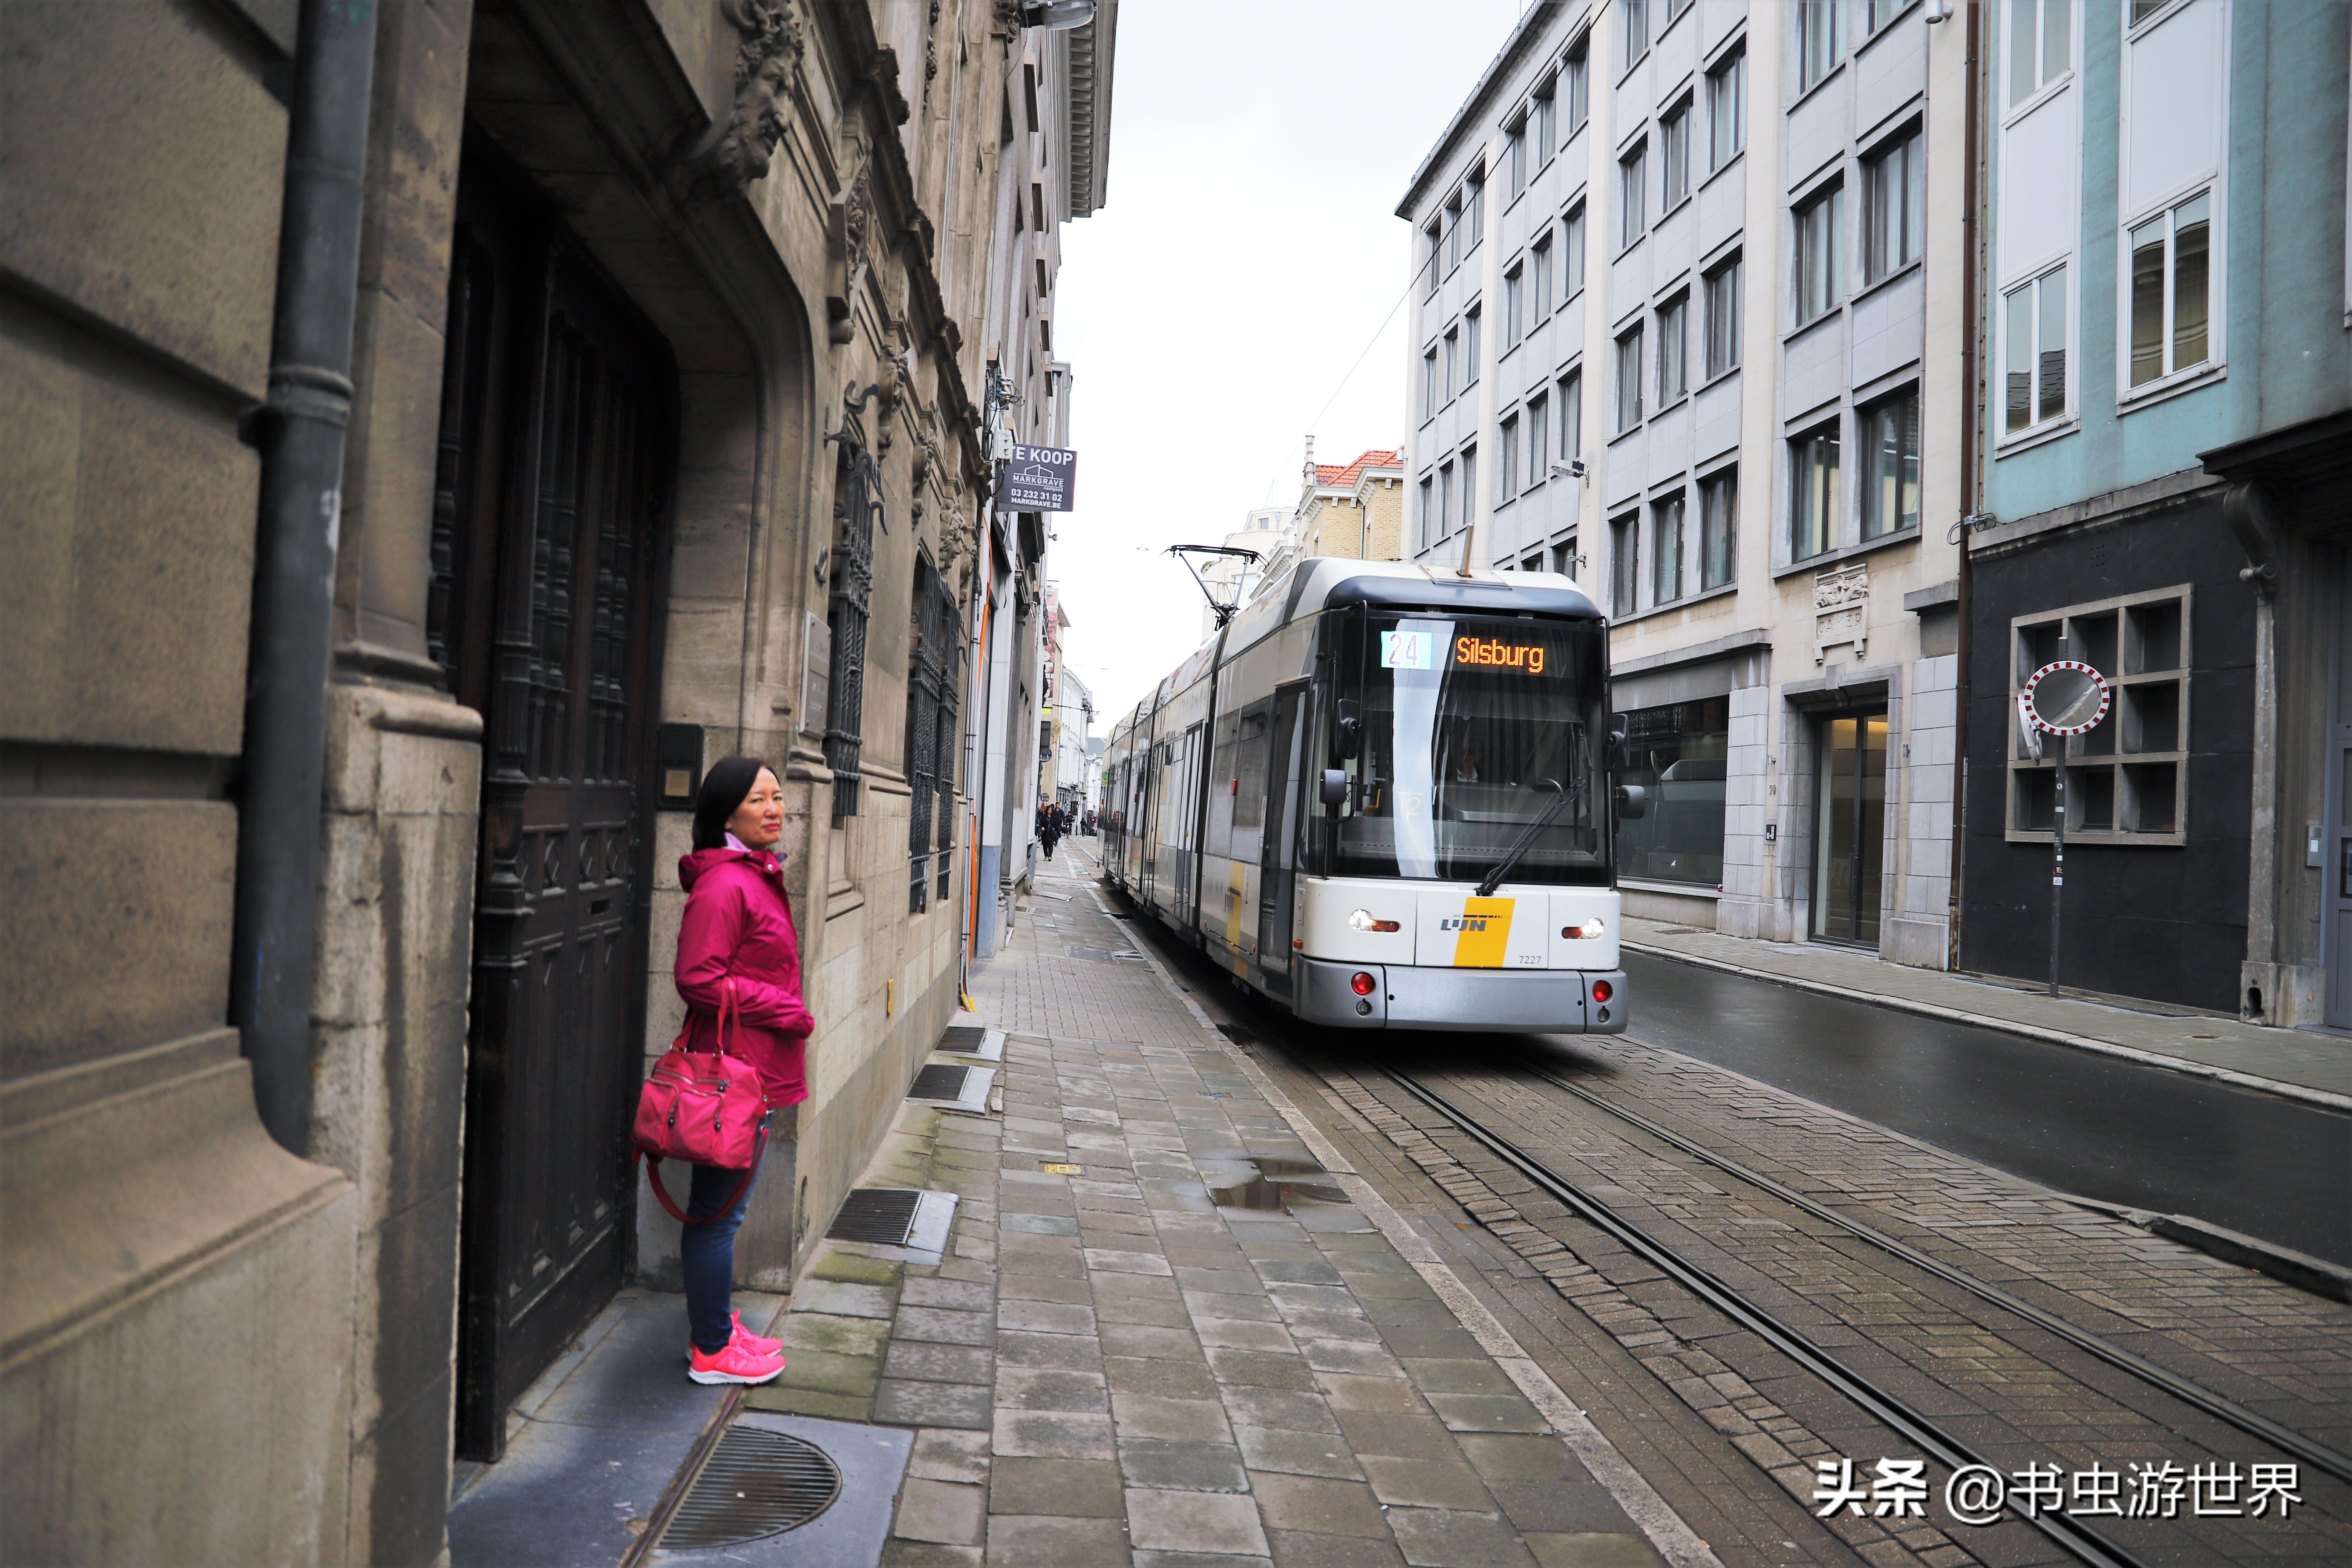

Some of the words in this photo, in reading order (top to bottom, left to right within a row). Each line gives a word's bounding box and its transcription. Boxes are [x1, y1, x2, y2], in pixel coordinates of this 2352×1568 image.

[1030, 448, 1073, 466] KOOP
[1013, 475, 1064, 487] MARKGRAVE
[1011, 488, 1021, 497] 03
[1023, 490, 1038, 499] 232
[1040, 492, 1050, 500] 31
[1052, 493, 1063, 502] 02
[1011, 497, 1061, 509] MARKGRAVE.BE
[1389, 634, 1418, 666] 24
[1456, 637, 1544, 673] Silsburg
[1441, 919, 1487, 931] LIJN
[1519, 956, 1541, 964] 7227
